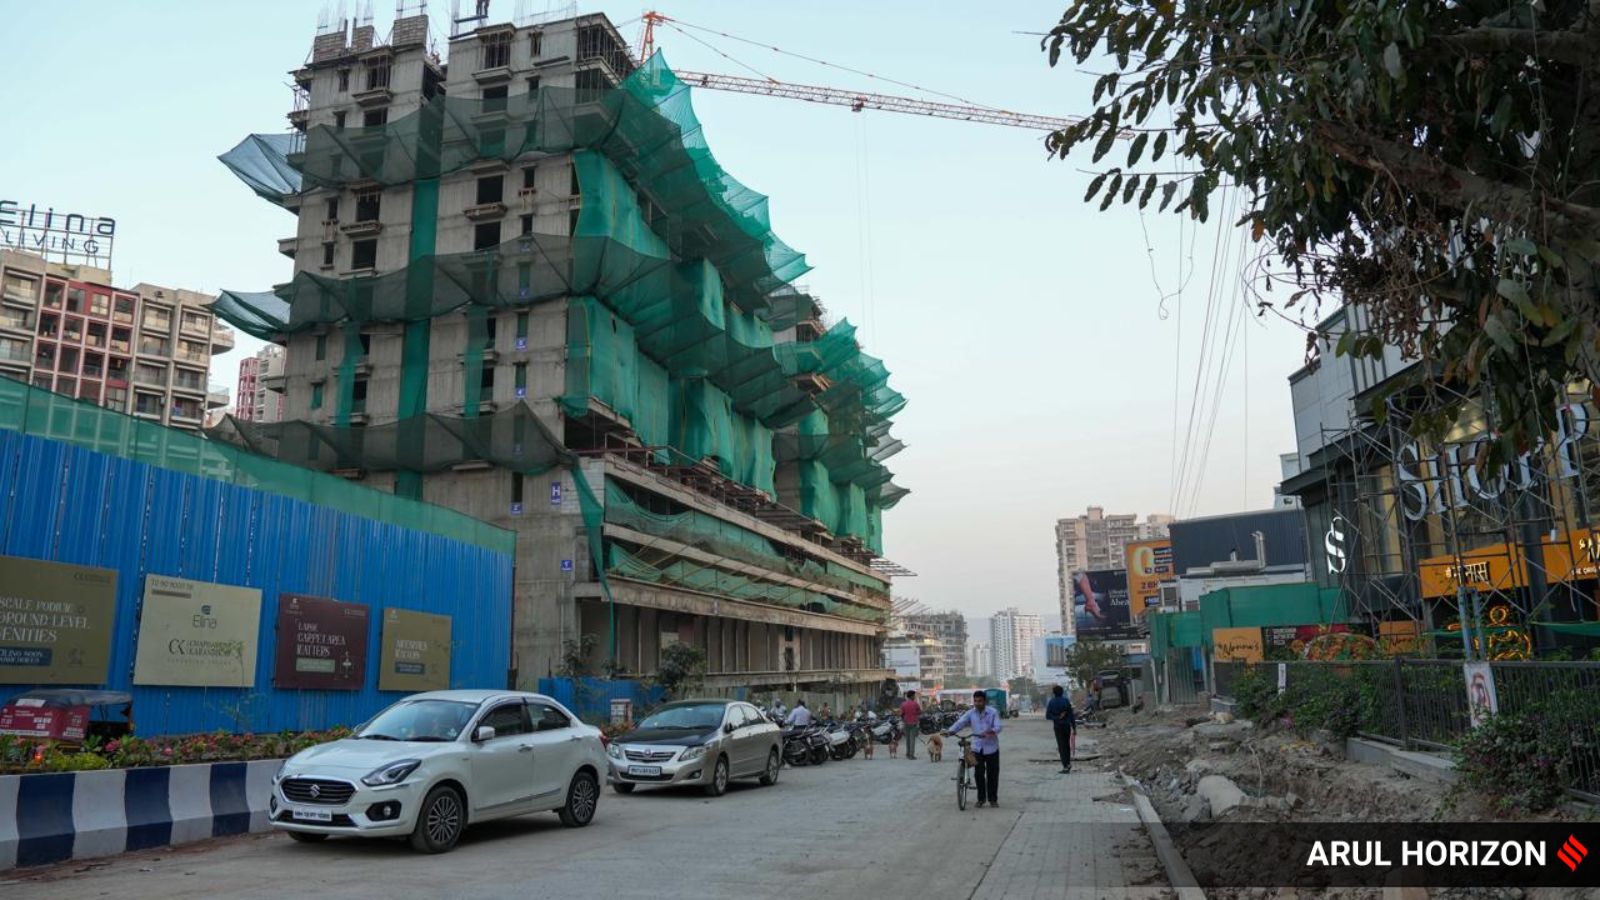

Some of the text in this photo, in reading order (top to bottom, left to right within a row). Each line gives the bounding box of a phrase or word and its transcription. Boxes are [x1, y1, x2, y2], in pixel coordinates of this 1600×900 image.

[0, 200, 116, 235] Elina
[5, 230, 99, 254] LIVING
[192, 614, 217, 630] Elina
[0, 626, 58, 642] ENITIES
